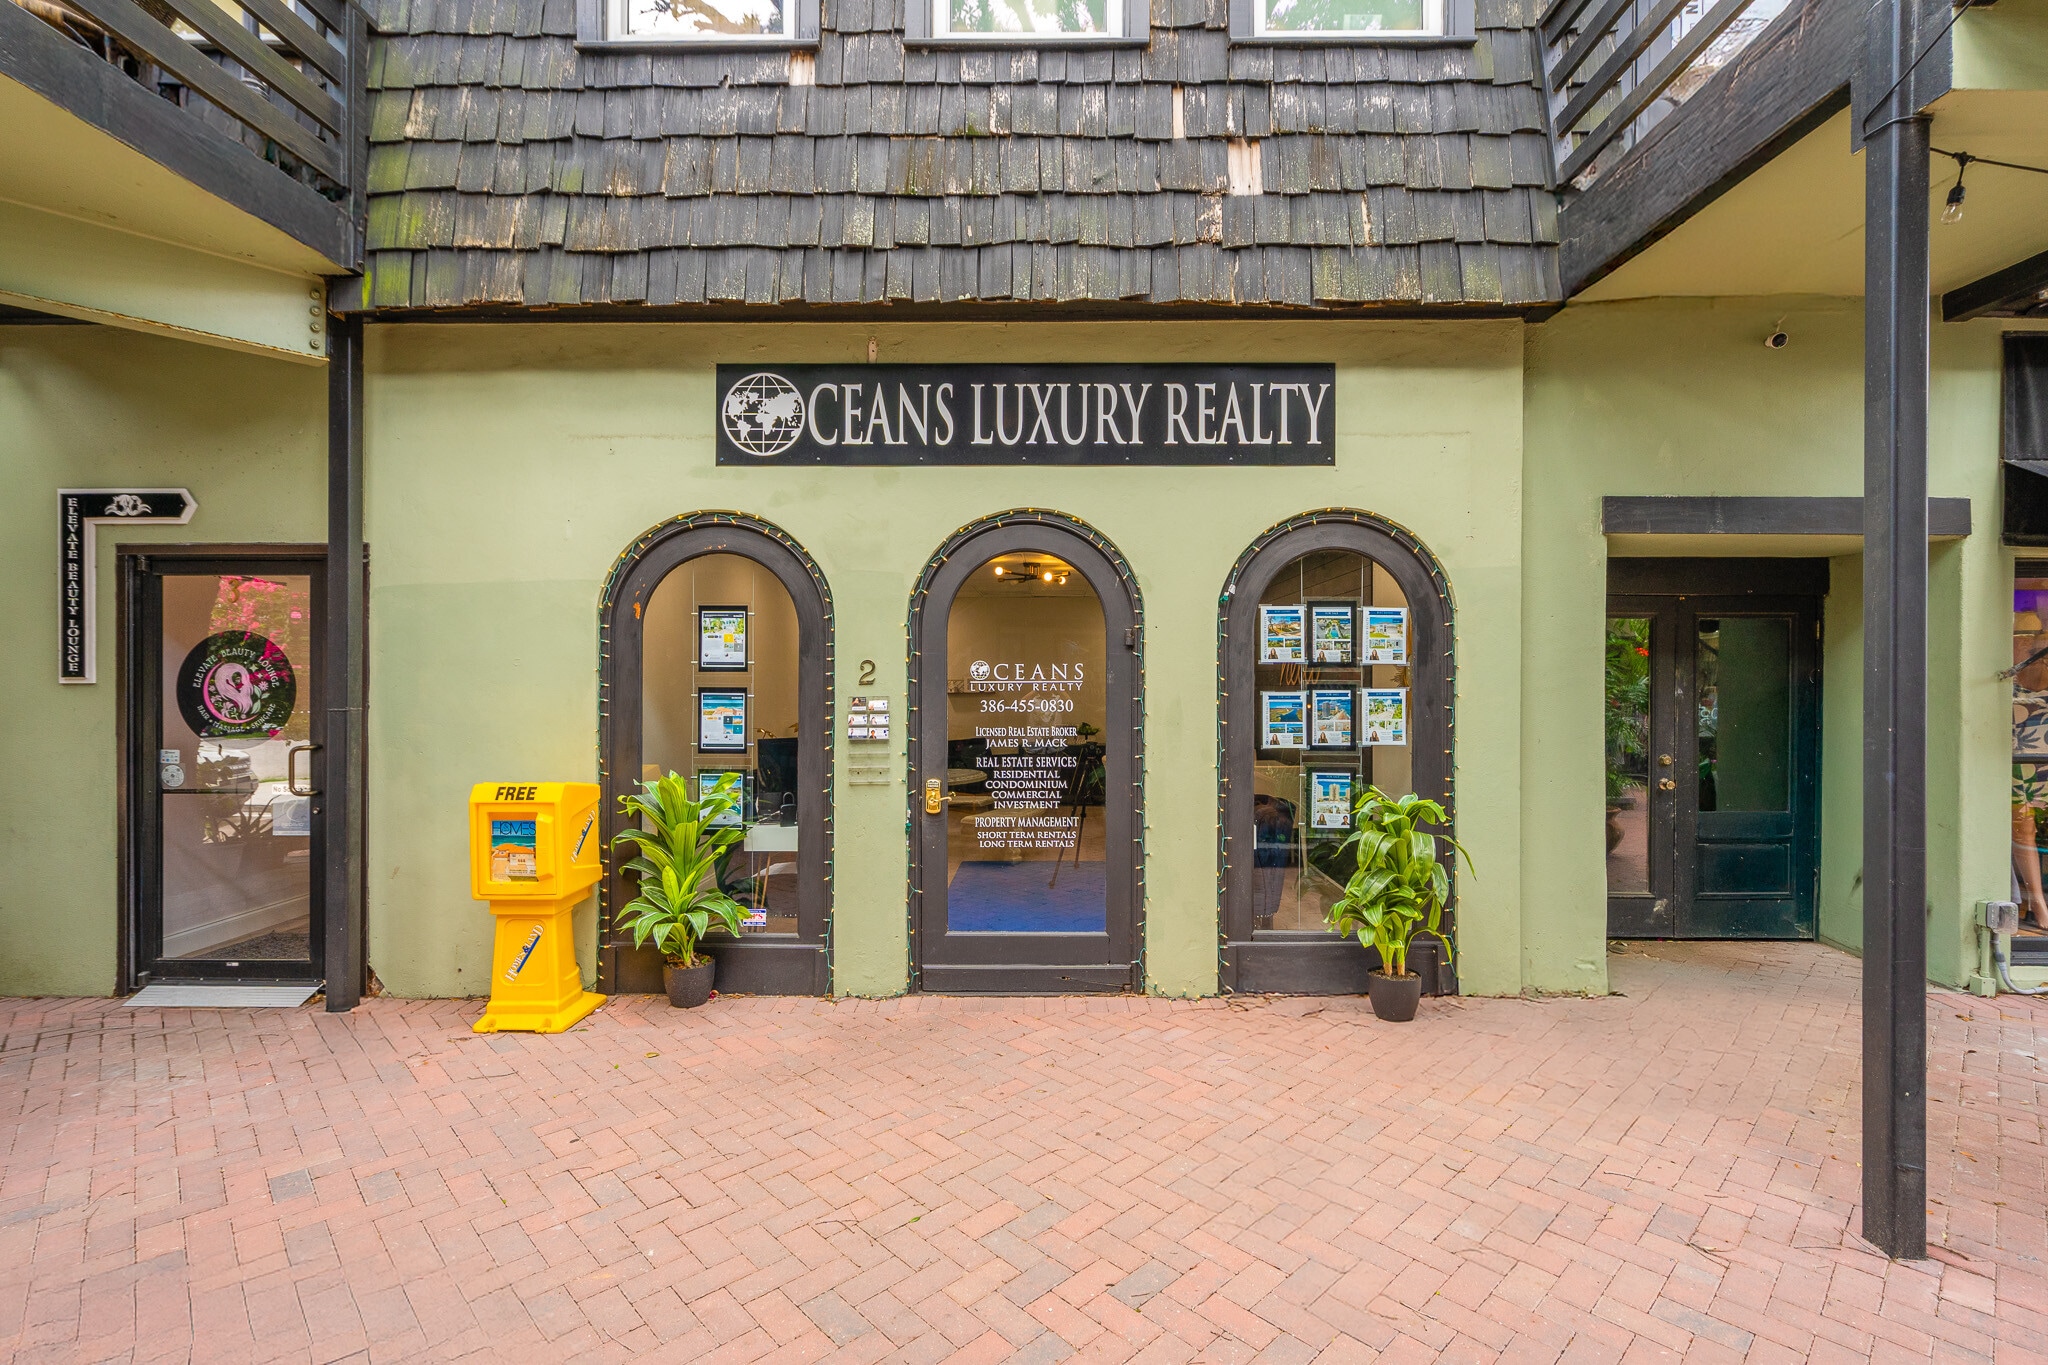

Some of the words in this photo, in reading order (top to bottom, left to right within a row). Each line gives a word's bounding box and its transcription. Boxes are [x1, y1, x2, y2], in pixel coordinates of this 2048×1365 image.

[970, 382, 1153, 446] LUXURY
[1164, 382, 1331, 446] REALTY
[67, 497, 79, 559] ELEVATE
[67, 563, 79, 615] BEAUTY
[67, 619, 80, 672] LOUNGE
[192, 654, 218, 688] ELEVATE
[220, 647, 256, 659] BEAUTY
[257, 656, 280, 688] LOUNGE
[858, 659, 876, 686] 2
[970, 683, 1023, 692] LUXURY
[1032, 683, 1083, 692] REALTY
[980, 699, 1074, 713] 386-455-0830
[196, 704, 210, 721] HAIR
[212, 720, 246, 733] MASSAGE
[251, 703, 276, 729] SKINCARE
[975, 726, 1007, 737] LICENSED
[1008, 726, 1025, 737] REAL
[1027, 726, 1050, 737] ESTATE
[1051, 726, 1078, 737] BROKER
[985, 738, 1018, 749] JAMES
[1021, 738, 1032, 747] R.
[1034, 738, 1068, 748] MACK
[976, 757, 1000, 768] REAL
[1001, 757, 1034, 768] ESTATE
[1035, 757, 1077, 768] SERVICES
[993, 770, 1060, 779] RESIDENTIAL
[985, 780, 1068, 789] CONDOMINIUM
[494, 786, 538, 801] FREE
[991, 790, 1062, 799] COMMERCIAL
[994, 801, 1060, 809] INVESTMENT
[975, 817, 1016, 828] PROPERTY
[1017, 817, 1079, 828] MANAGEMENT
[492, 821, 536, 836] HOMES
[977, 831, 1007, 839] SHORT
[1008, 831, 1035, 839] TERM
[1037, 831, 1077, 839] RENTALS
[979, 840, 1005, 848] LONG
[1008, 840, 1035, 848] TERM
[1035, 840, 1075, 848] RENTALS
